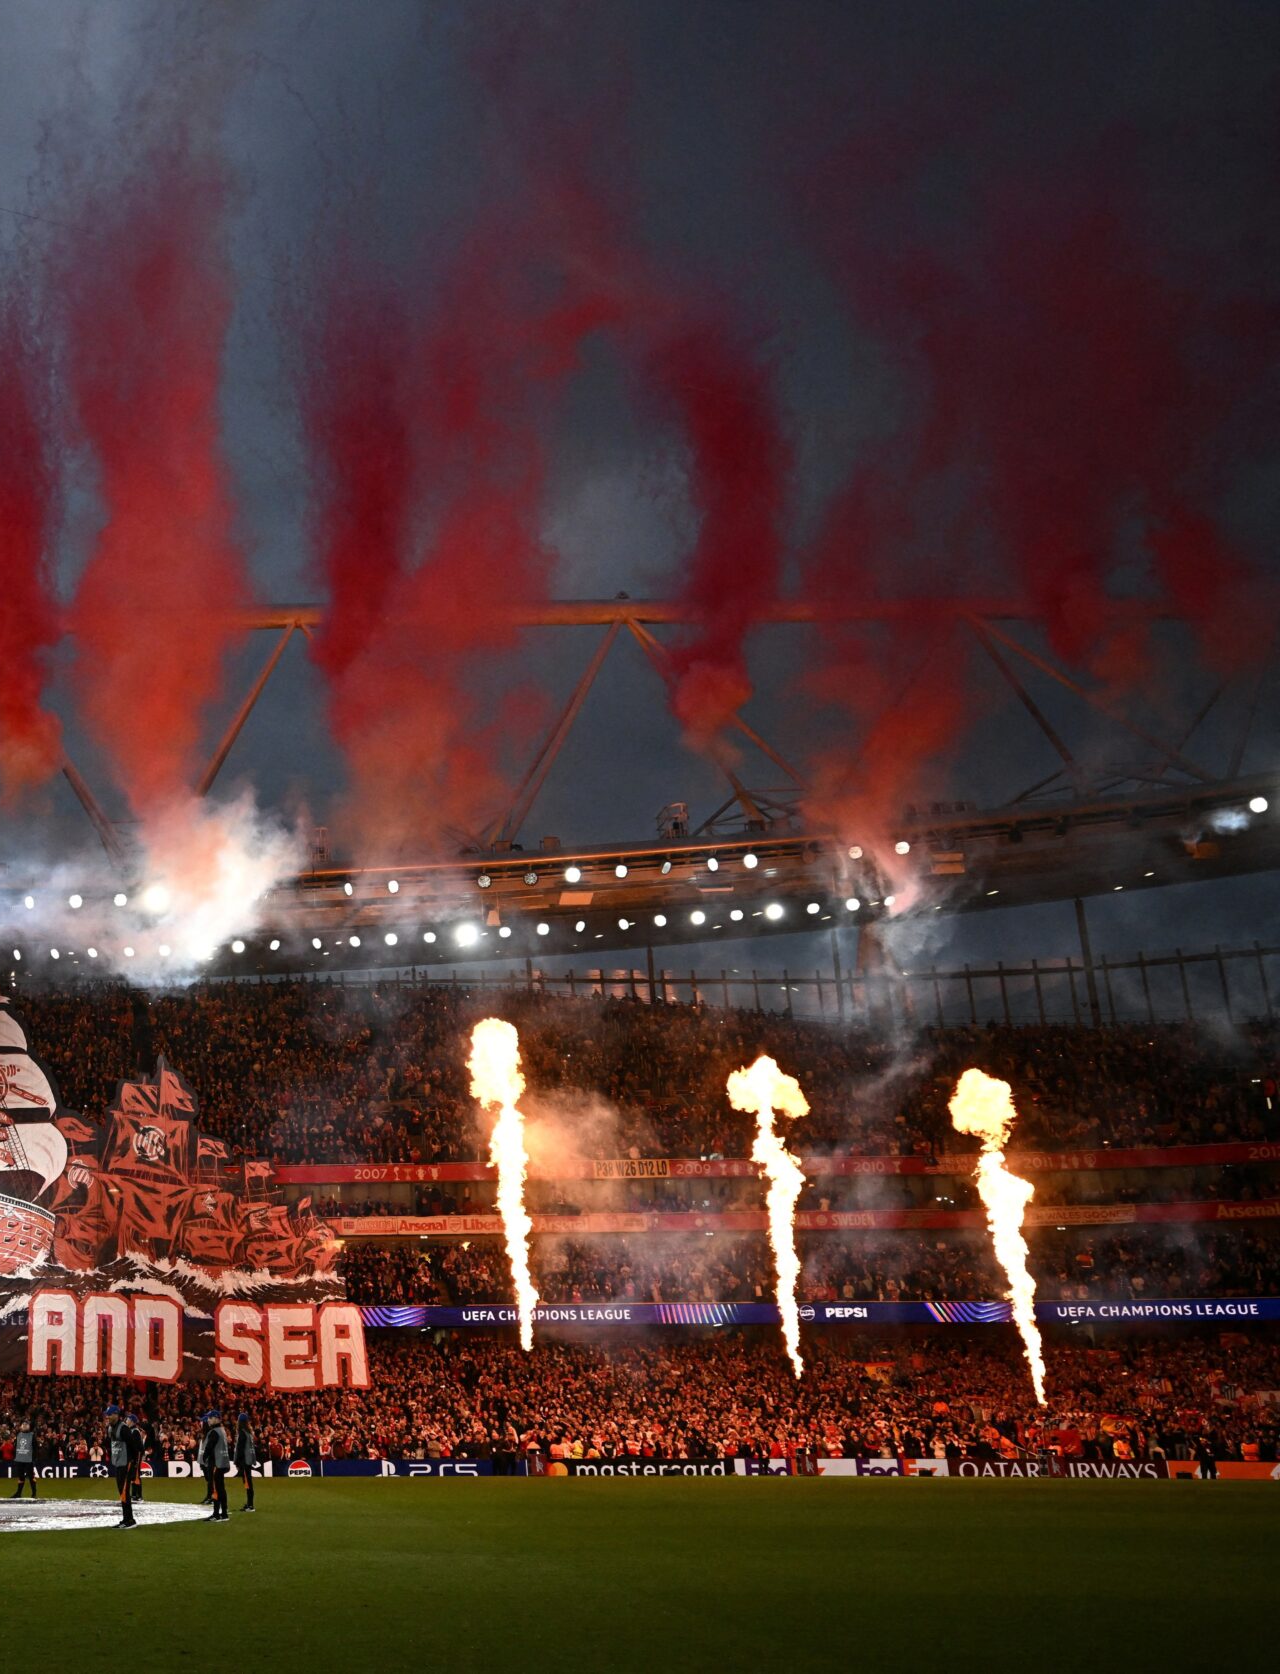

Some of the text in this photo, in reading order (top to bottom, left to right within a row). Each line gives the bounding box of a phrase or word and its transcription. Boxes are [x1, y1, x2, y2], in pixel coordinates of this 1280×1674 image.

[676, 1163, 711, 1175] 2009
[853, 1162, 885, 1173] 2010
[1023, 1158, 1054, 1169] 2011
[354, 1168, 388, 1180] 2007
[1216, 1203, 1280, 1218] Arsenal
[399, 1219, 448, 1231] Arsenal
[831, 1213, 876, 1226] SWEDEN
[462, 1310, 495, 1321] UEFA
[580, 1309, 631, 1320] LEAGUE
[825, 1307, 868, 1318] PEPSI
[1057, 1304, 1260, 1318] UEFA CHAMPIONS LEAGUE
[25, 1290, 184, 1383] AND
[214, 1298, 372, 1391] SEA
[8, 1466, 79, 1478] LAGUE
[958, 1461, 1159, 1478] QATAR IRWAYS
